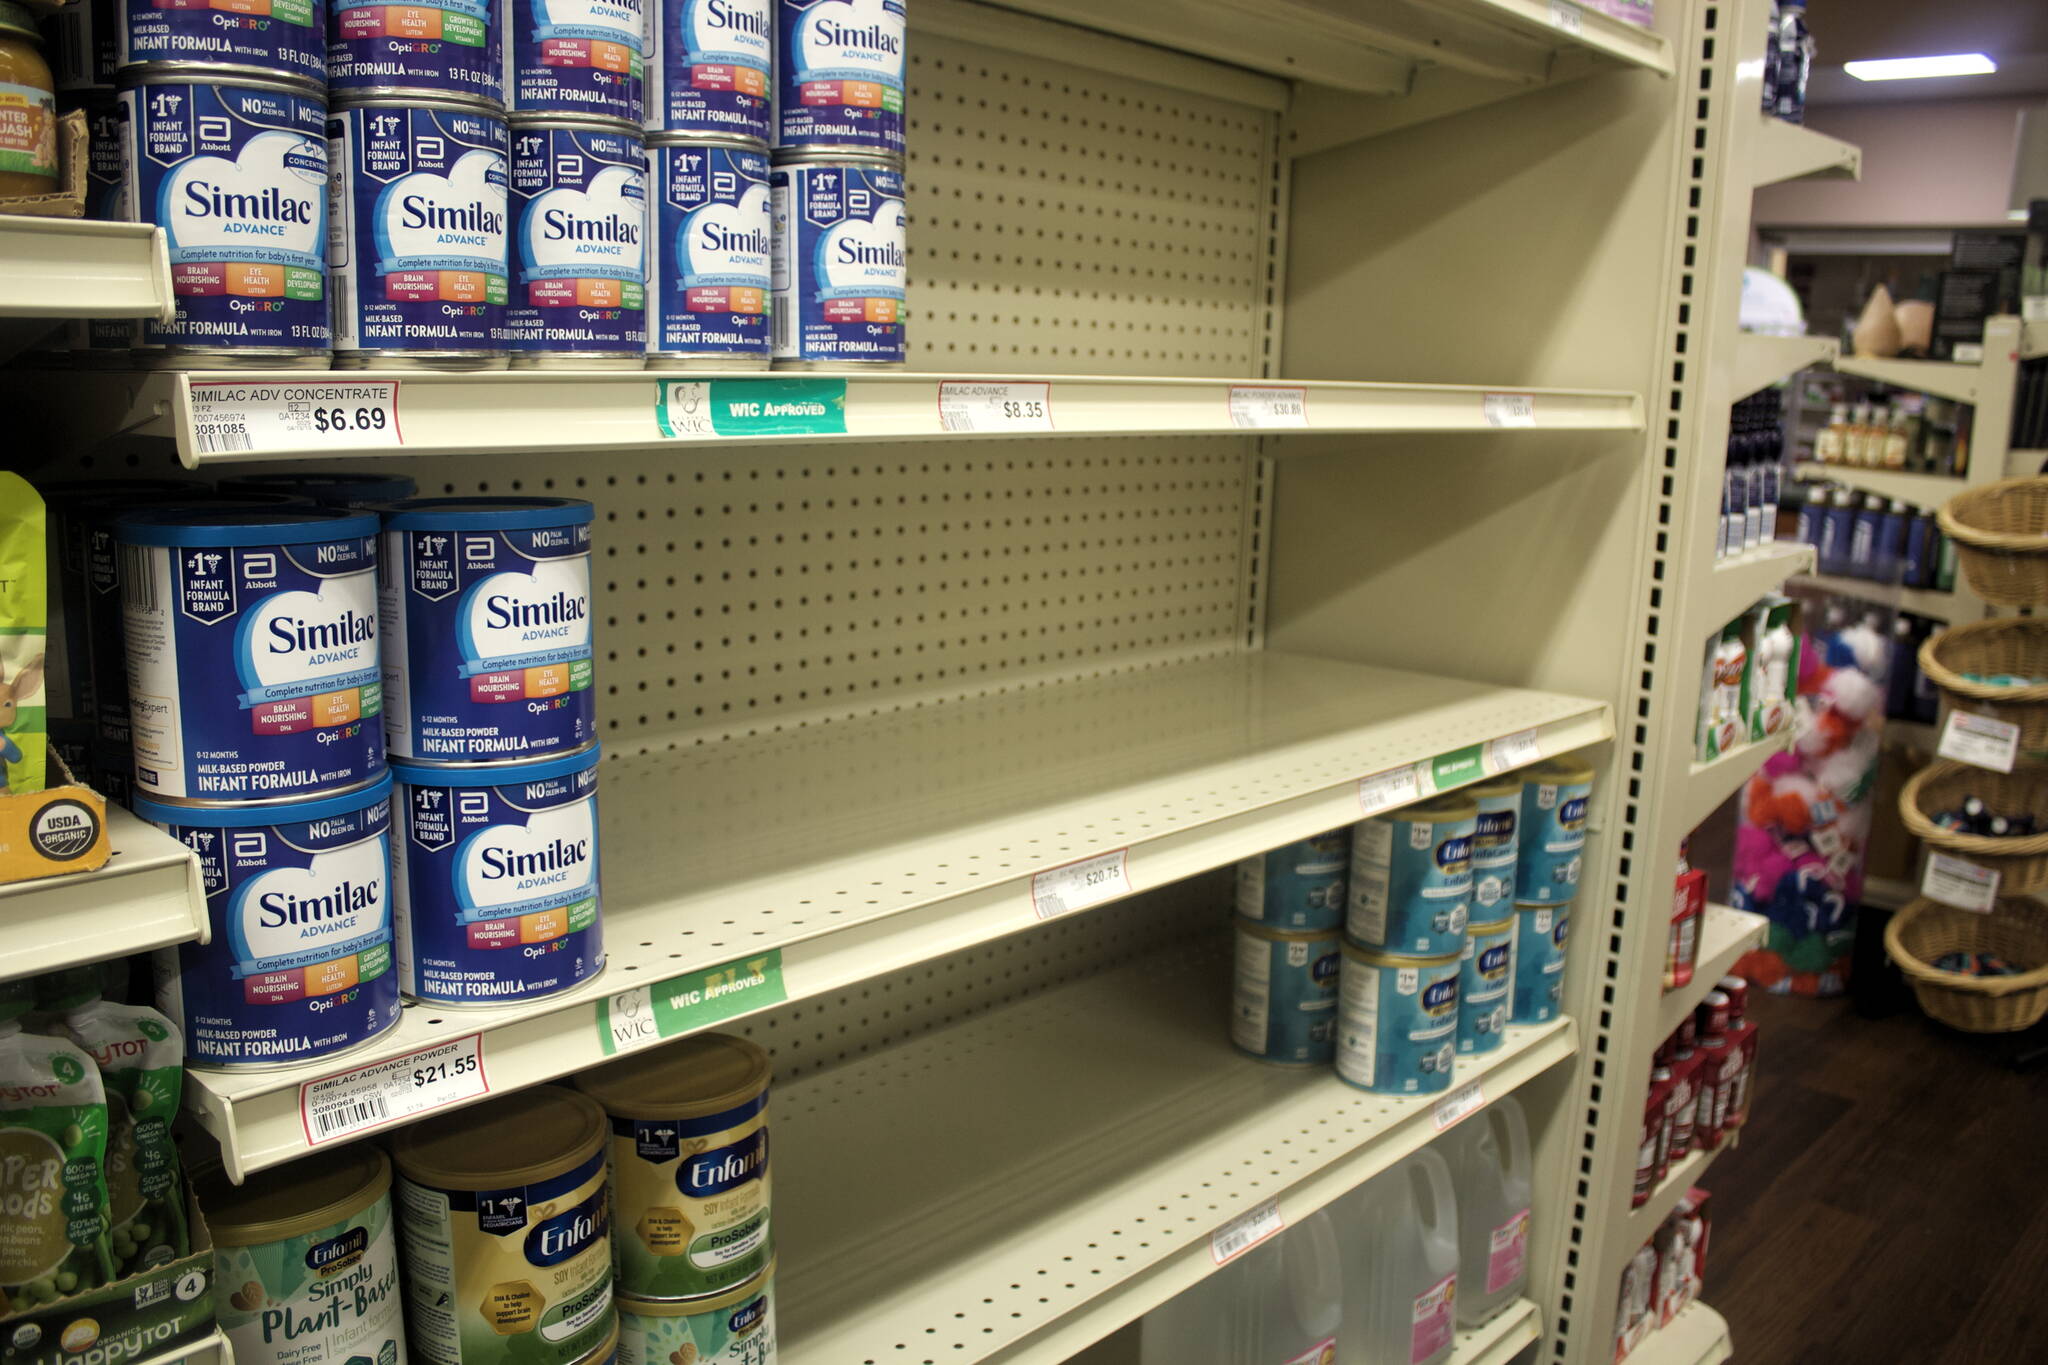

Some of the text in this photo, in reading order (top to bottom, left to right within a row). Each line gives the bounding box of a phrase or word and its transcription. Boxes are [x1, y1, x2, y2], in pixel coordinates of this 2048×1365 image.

[590, 6, 630, 22] ADVANCE
[707, 0, 771, 39] Simila
[134, 24, 169, 34] MILK-BASED
[134, 36, 232, 52] INFANT FORMULA
[278, 48, 309, 65] 13 FL OZ
[842, 50, 883, 62] ADVANCE
[355, 62, 405, 76] FORMULA
[521, 89, 607, 104] INFANT FORMULA
[151, 93, 168, 117] #1
[242, 97, 261, 114] NO
[0, 111, 28, 124] NTER
[671, 109, 747, 126] INFANT FORMULA
[153, 121, 183, 132] INFANT
[784, 124, 857, 137] INFANT FORMULA
[150, 132, 188, 143] FORMULA
[154, 143, 183, 154] BRAND
[201, 143, 231, 152] Abbott
[367, 151, 405, 161] FORMULA
[185, 181, 312, 225] Similac
[402, 195, 502, 235] Similac
[224, 223, 285, 236] ADVANCE
[544, 209, 638, 245] Similac
[437, 234, 486, 246] ADVANCE
[576, 245, 621, 255] ADVANCE
[244, 276, 269, 285] HEALTH
[190, 322, 248, 335] FORMULA
[365, 325, 458, 338] INFANT FORMULA
[509, 329, 594, 340] INFANT FORMULA
[666, 333, 743, 345] INFANT FORMULA
[806, 342, 878, 353] INFANT FORMULA
[190, 388, 387, 402] SIMILAC ADV CONCENTRATE
[971, 387, 1008, 396] ADVANCE
[729, 403, 760, 417] WIC
[1004, 401, 1042, 418] $8.35
[315, 407, 386, 433] $6.69
[672, 420, 714, 433] WIC
[188, 553, 206, 575] #1
[420, 561, 448, 569] INFANT
[416, 570, 453, 580] FORMULA
[190, 580, 223, 589] INFANT
[245, 581, 277, 589] Abbott
[187, 591, 230, 601] FORMULA
[193, 602, 224, 612] BRAND
[487, 592, 585, 629] Similac
[269, 611, 375, 653] Similac
[521, 627, 568, 641] ADVANCE
[308, 648, 359, 666] ADVANCE
[265, 686, 303, 698] Complete
[305, 679, 335, 693] nutrition
[336, 677, 346, 686] for
[261, 712, 307, 724] NOURISHING
[422, 727, 498, 737] MILK-BASED POWDER
[423, 736, 529, 753] INFANT FORMULA
[198, 761, 285, 774] MILK-BASED POWDER
[198, 768, 351, 792] INFANT FORMULA WITH IRON
[48, 815, 81, 829] USDA
[331, 819, 345, 827] PALM
[45, 830, 86, 844] ORGANIC
[309, 823, 331, 840] NO
[236, 858, 267, 867] Abbott
[482, 839, 586, 879] Similac
[517, 871, 567, 890] ADVANCE
[1086, 865, 1120, 886] $20.75
[260, 879, 377, 928] Similac
[300, 916, 356, 938] ADVANCE
[265, 974, 287, 983] BRAIN
[424, 970, 495, 980] MILK-BASED POWDER
[253, 982, 299, 994] NOURISHING
[424, 980, 525, 996] INFANT FORMULA
[670, 991, 700, 1010] WIC
[614, 1019, 655, 1042] WIC
[197, 1033, 347, 1056] INFANT FORMULA WITH IRON
[313, 1044, 458, 1093] SIMILAC ADVANCE POWDER
[414, 1054, 476, 1088] $21.55
[312, 1098, 355, 1115] 3080968
[185, 1278, 196, 1293] 4
[308, 1264, 372, 1302] Simply
[277, 1342, 321, 1360] Dairy Free
